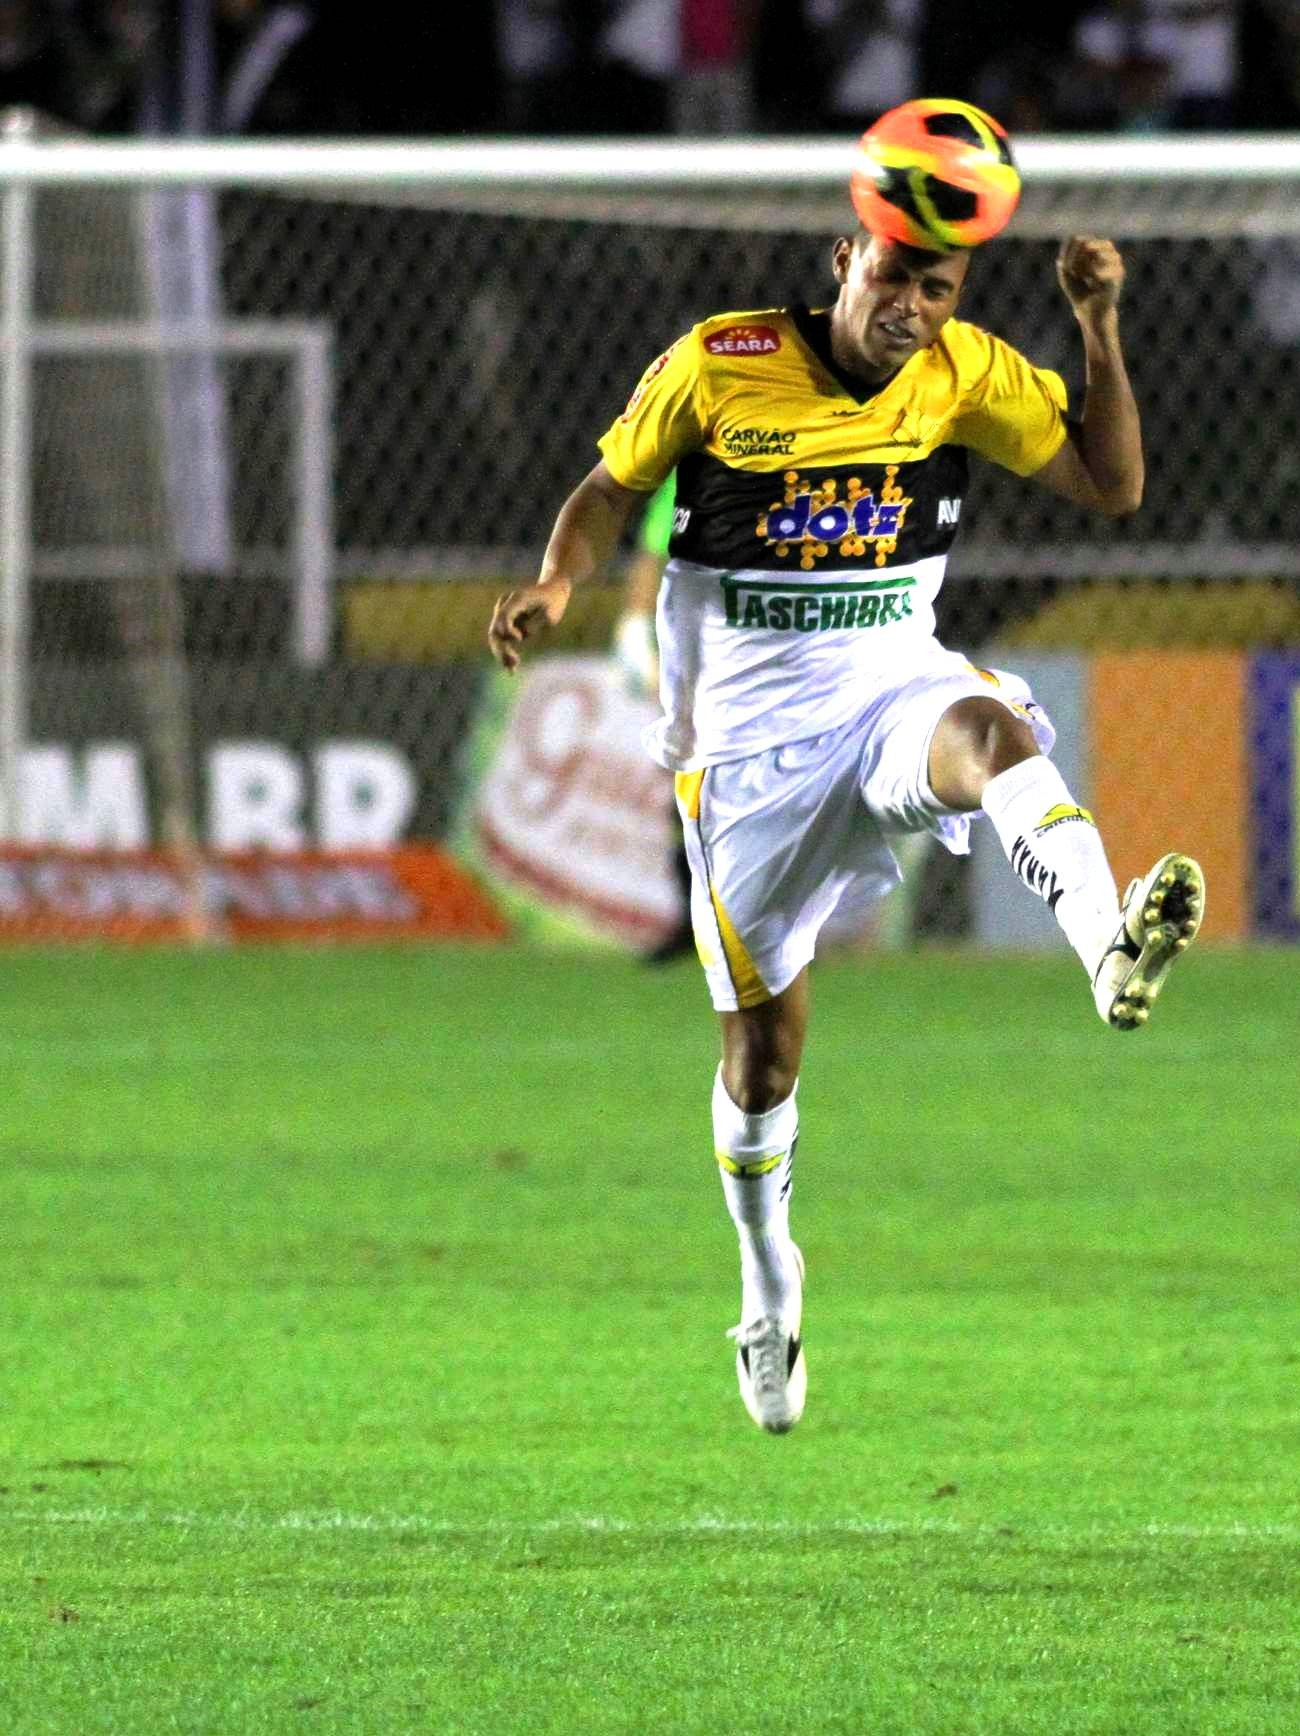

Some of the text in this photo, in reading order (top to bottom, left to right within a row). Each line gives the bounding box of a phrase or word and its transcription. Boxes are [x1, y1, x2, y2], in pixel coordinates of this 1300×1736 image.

[709, 338, 777, 354] SEARA
[721, 428, 797, 443] CARVÃO
[766, 495, 906, 541] dotz
